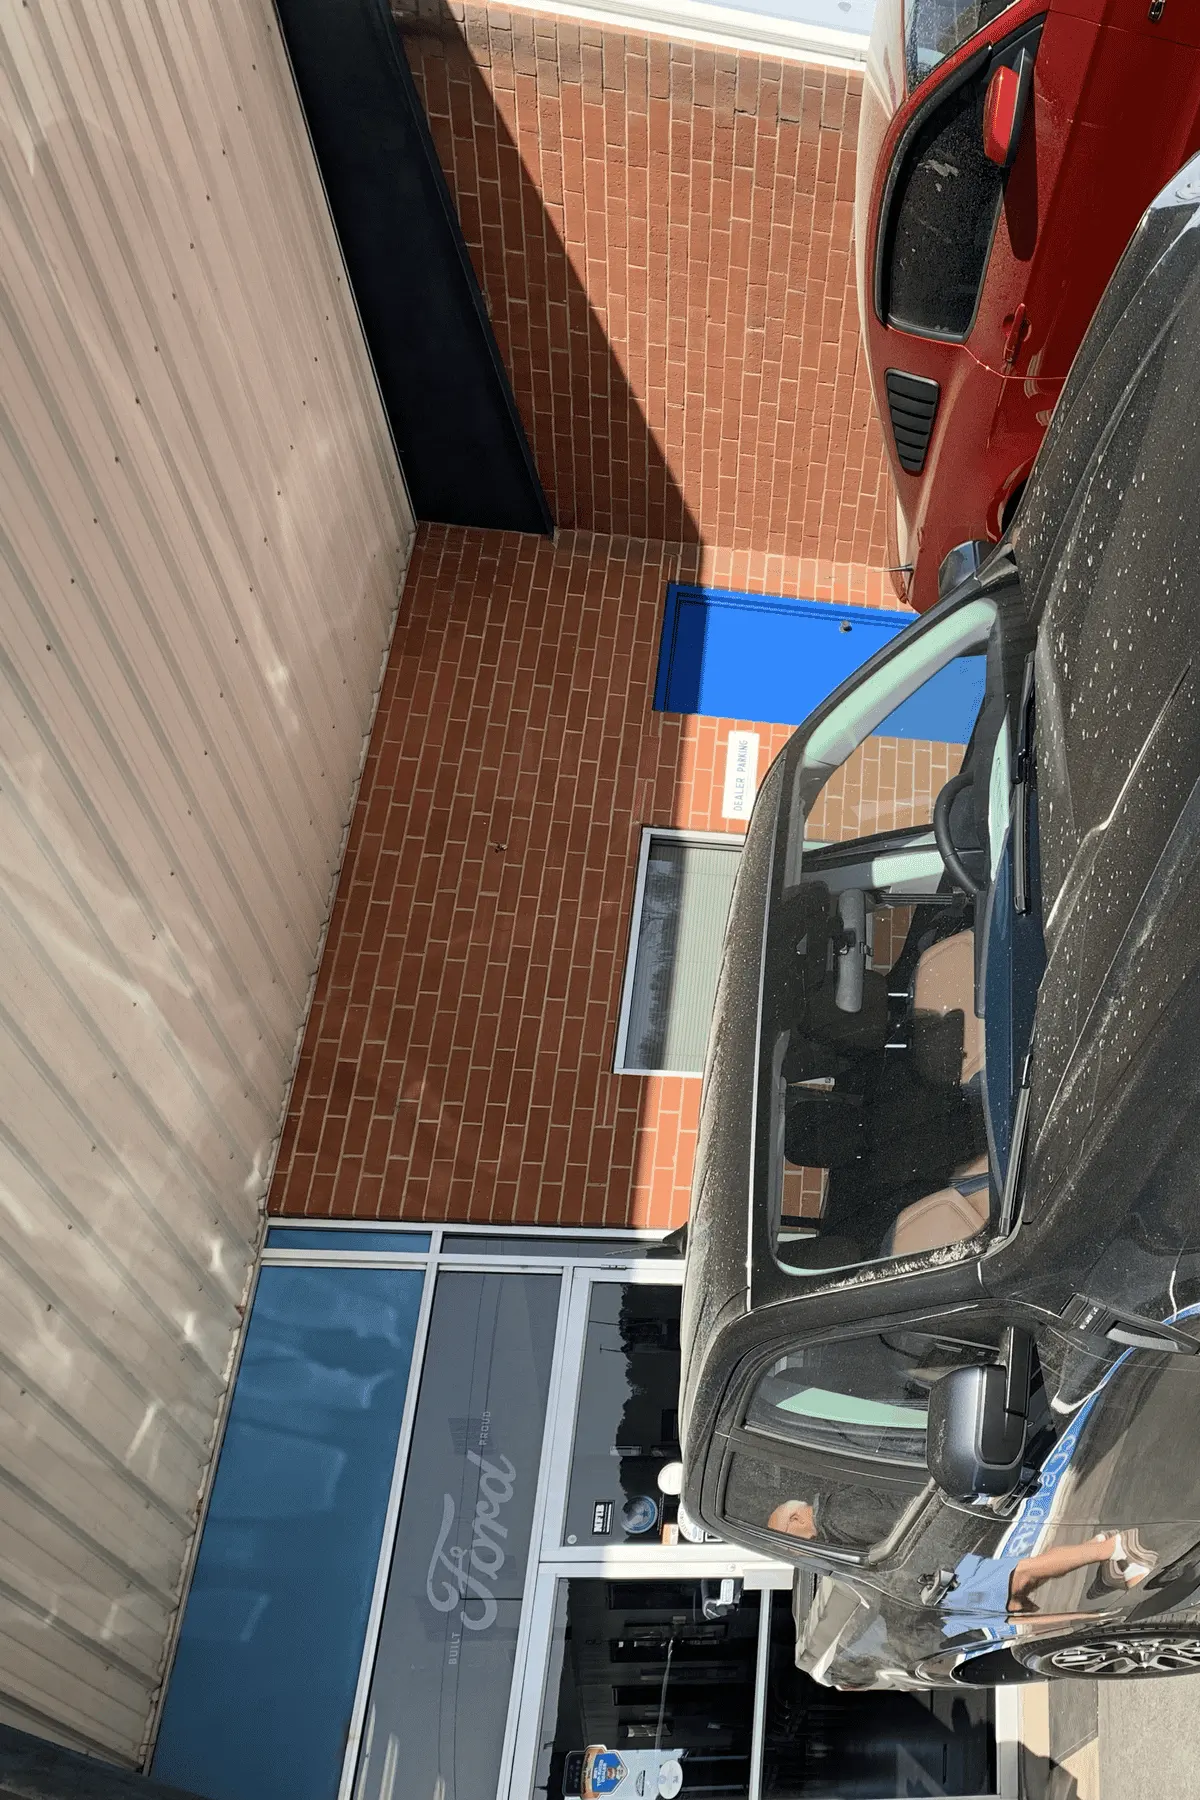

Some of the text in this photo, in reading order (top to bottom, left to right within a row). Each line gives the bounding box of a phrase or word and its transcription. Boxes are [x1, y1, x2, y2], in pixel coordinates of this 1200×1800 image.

[733, 739, 749, 812] DEALER PARKING
[426, 1410, 517, 1665] BUILT Ford PROUD
